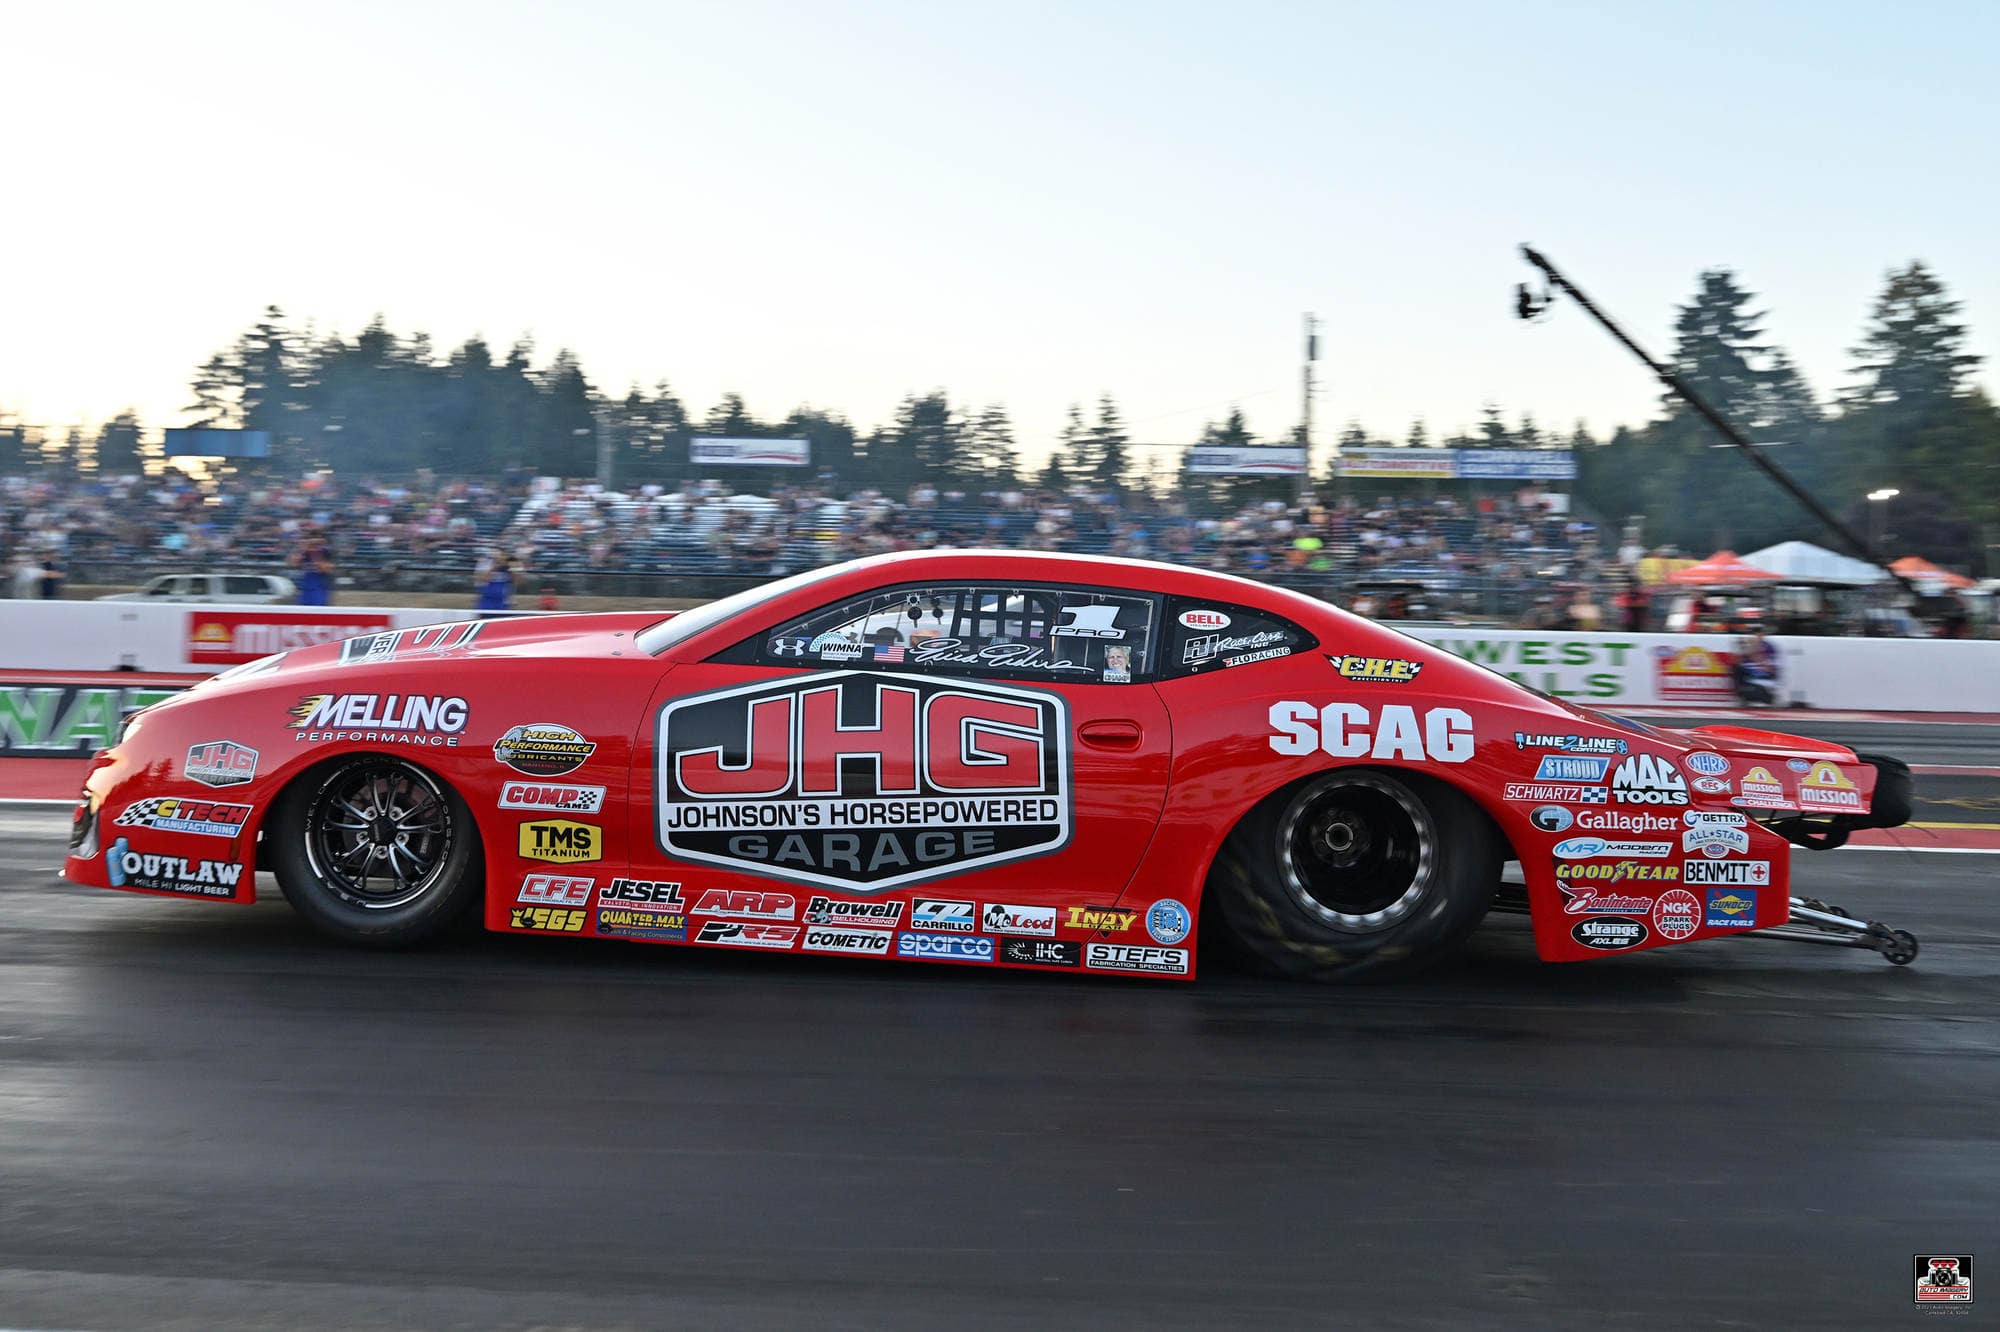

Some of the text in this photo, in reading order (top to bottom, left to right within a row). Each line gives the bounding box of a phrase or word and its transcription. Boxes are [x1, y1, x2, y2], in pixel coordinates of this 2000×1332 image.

[1186, 614, 1224, 625] BELL
[1055, 627, 1121, 638] PRO
[824, 643, 862, 653] WIMNA
[302, 694, 468, 733] MELLING
[295, 732, 458, 747] PERFORMANCE
[523, 730, 577, 741] HIGH
[675, 683, 1045, 798] JHG
[1268, 700, 1475, 763] SCAG
[499, 740, 592, 753] PERFORMANCE
[189, 744, 255, 770] JHG
[1691, 755, 1727, 775] NHRA
[1544, 758, 1601, 779] STROUD
[1613, 753, 1688, 791] MAC
[506, 785, 580, 805] COMP
[1505, 785, 1579, 801] SCHWARTZ
[1613, 790, 1690, 805] TOOLS
[555, 802, 590, 810] CAMS
[668, 799, 1058, 829] JOHNSON'S HORSEPOWERED
[154, 818, 237, 836] MANUFACTURING
[1576, 810, 1678, 834] Gallagher
[1702, 813, 1745, 823] GETTRX
[530, 825, 592, 849] TMS
[1688, 829, 1744, 843] ALL STAR
[531, 848, 590, 858] TITANIUM
[728, 831, 996, 872] GARAGE
[121, 851, 243, 886] OUTLAW
[1685, 861, 1750, 883] BENMIT
[134, 878, 159, 888] MILE
[174, 882, 203, 893] LIGHT
[203, 885, 230, 896] BEER
[523, 877, 590, 900] CFE
[600, 879, 685, 904] JESEL
[695, 890, 795, 915] ARP
[807, 897, 904, 918] Browell
[1662, 902, 1692, 914] NGK
[1710, 900, 1752, 910] SUNOCO
[600, 910, 685, 929] QUARTER-MAX
[832, 915, 895, 925] BELLHOUSING
[912, 920, 973, 931] CARRILLO
[984, 912, 1055, 930] McLeod
[1581, 922, 1640, 937] Strange
[807, 931, 888, 950] COMETIC
[900, 930, 992, 957] sparco
[1588, 937, 1630, 945] AXLES
[1035, 942, 1065, 960] IHC
[1091, 945, 1182, 965] STEF'S
[1090, 960, 1184, 972] FABRICATION SPECIALTIES
